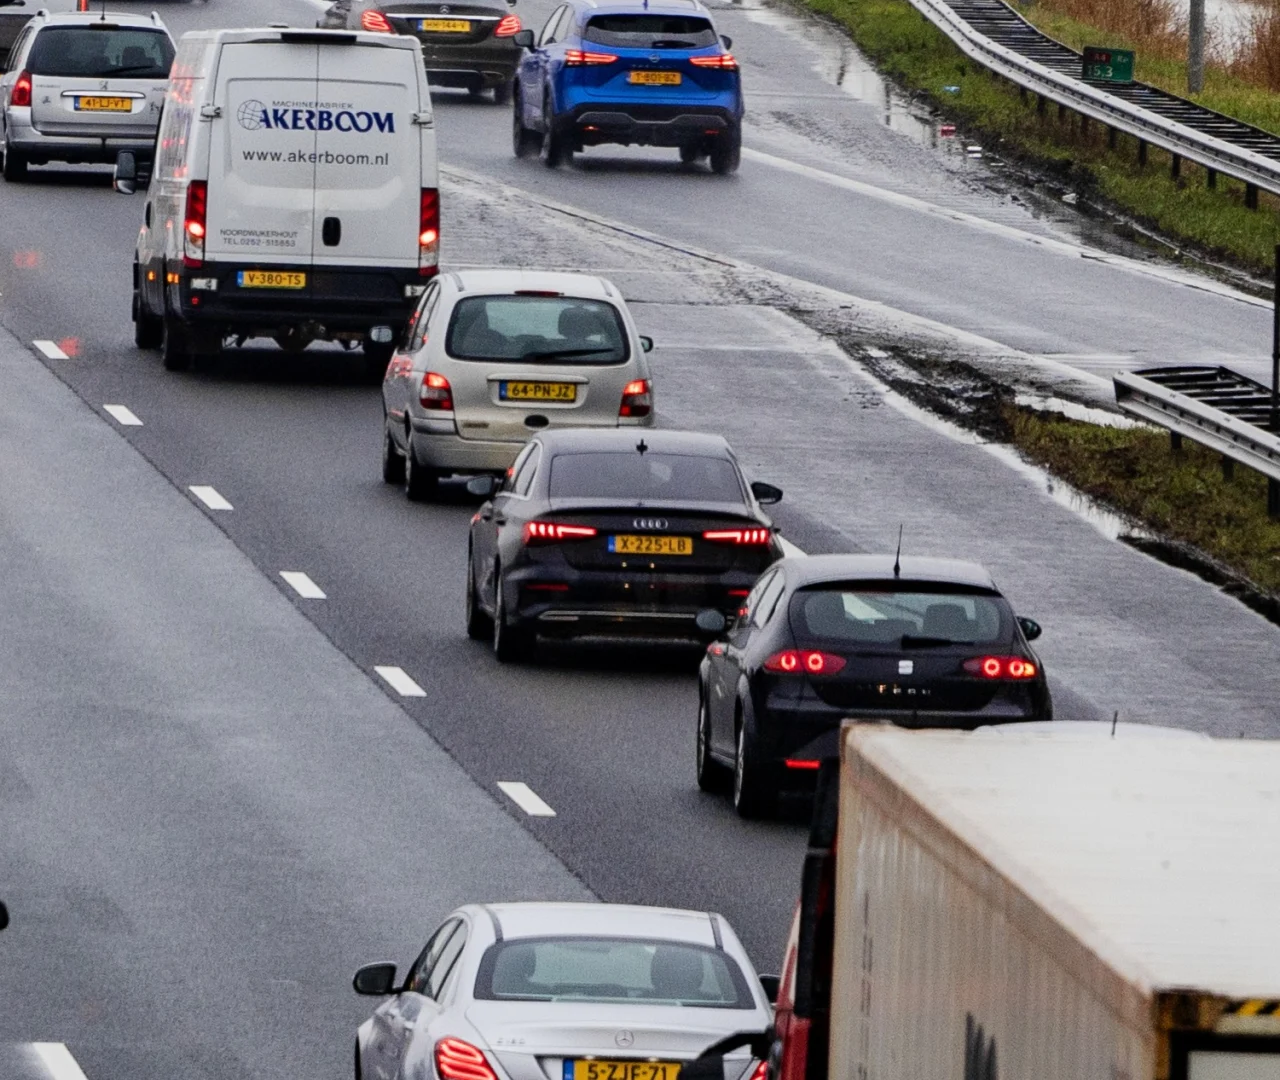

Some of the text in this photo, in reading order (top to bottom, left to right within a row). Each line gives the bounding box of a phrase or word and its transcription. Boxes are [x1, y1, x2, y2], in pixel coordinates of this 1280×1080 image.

[85, 100, 126, 109] 41-LJ-VT
[272, 100, 354, 110] MACHINEFABRIEK
[260, 108, 396, 134] AKERBOOM
[243, 149, 389, 166] www.akerboom.nl
[248, 273, 301, 286] V-380-TS
[511, 385, 570, 398] 64-PN-JZ
[620, 536, 686, 550] X-225-LB
